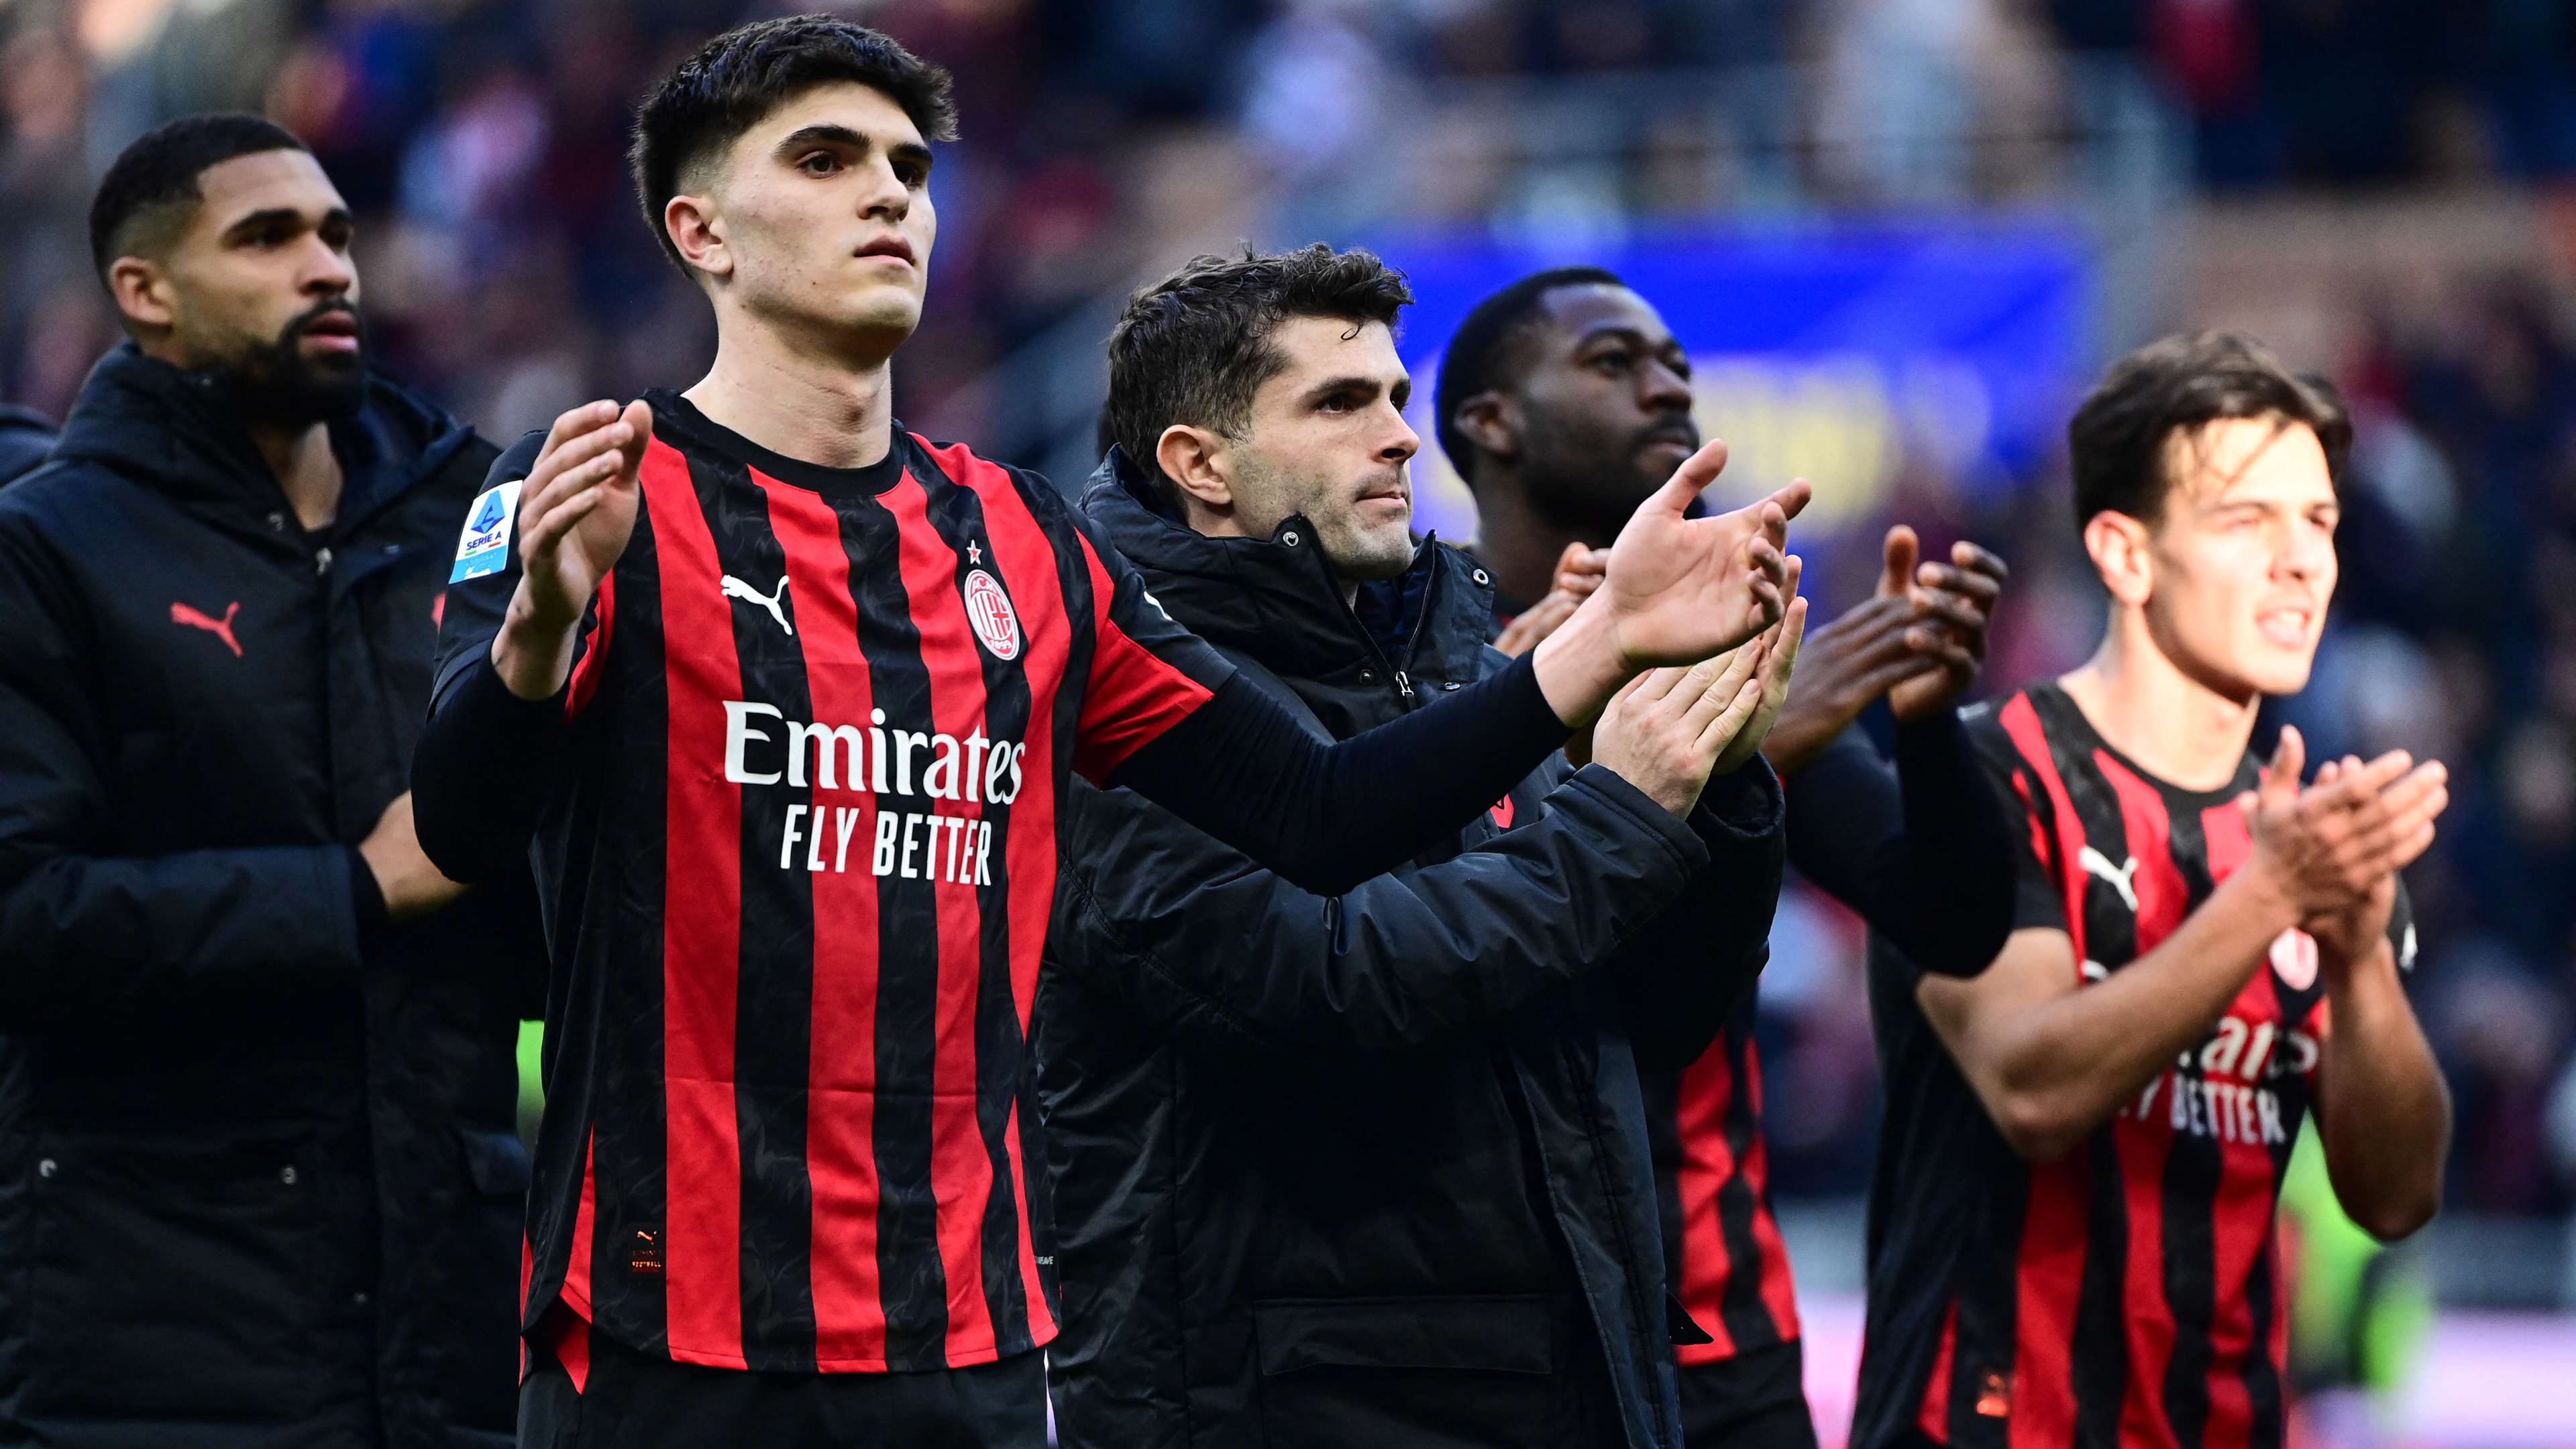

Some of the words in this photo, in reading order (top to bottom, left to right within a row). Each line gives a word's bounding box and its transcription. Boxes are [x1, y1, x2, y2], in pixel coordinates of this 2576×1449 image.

[466, 533, 494, 551] SERIE
[494, 531, 502, 540] A
[722, 700, 1026, 805] Emirates
[780, 804, 860, 873] FLY
[872, 810, 992, 886] BETTER
[2169, 1072, 2287, 1144] BETTER
